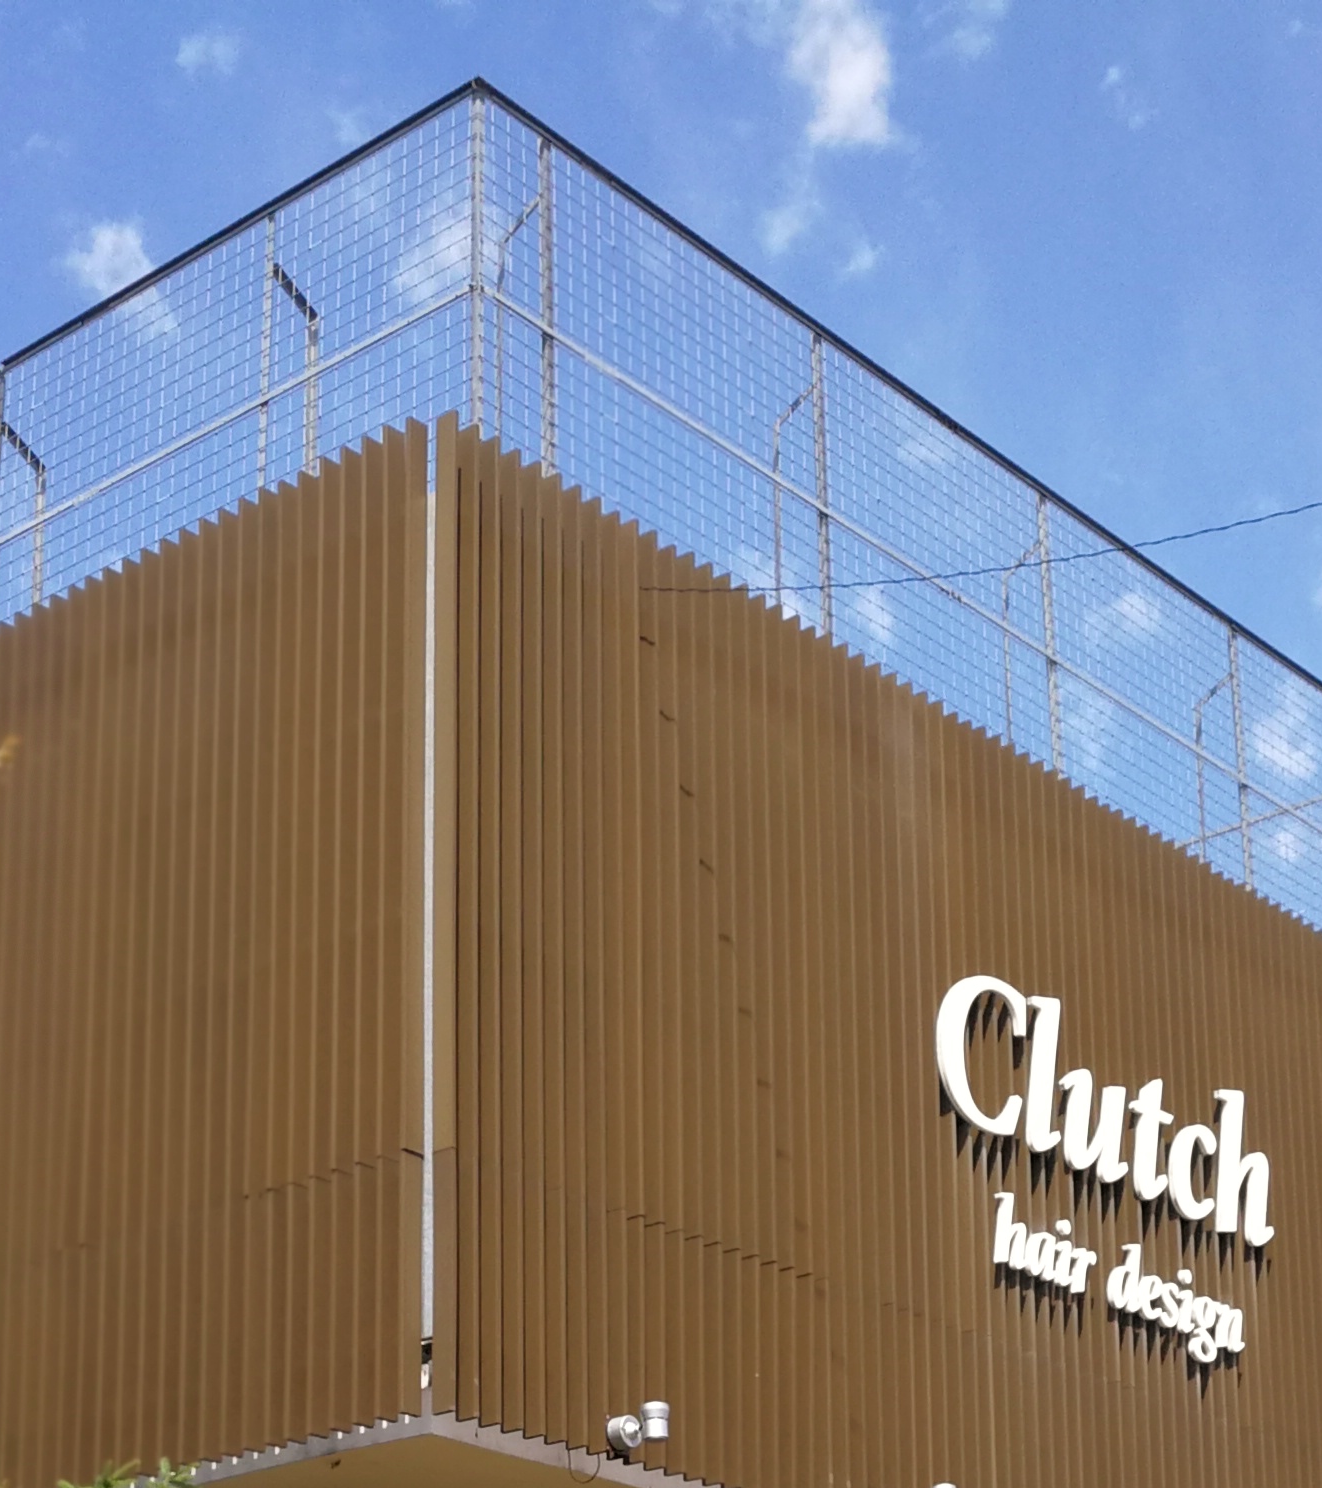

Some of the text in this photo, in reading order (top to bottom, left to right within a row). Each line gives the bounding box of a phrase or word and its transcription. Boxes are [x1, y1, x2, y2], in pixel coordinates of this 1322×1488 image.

[936, 975, 1275, 1247] Clutch
[993, 1191, 1246, 1364] hair design
